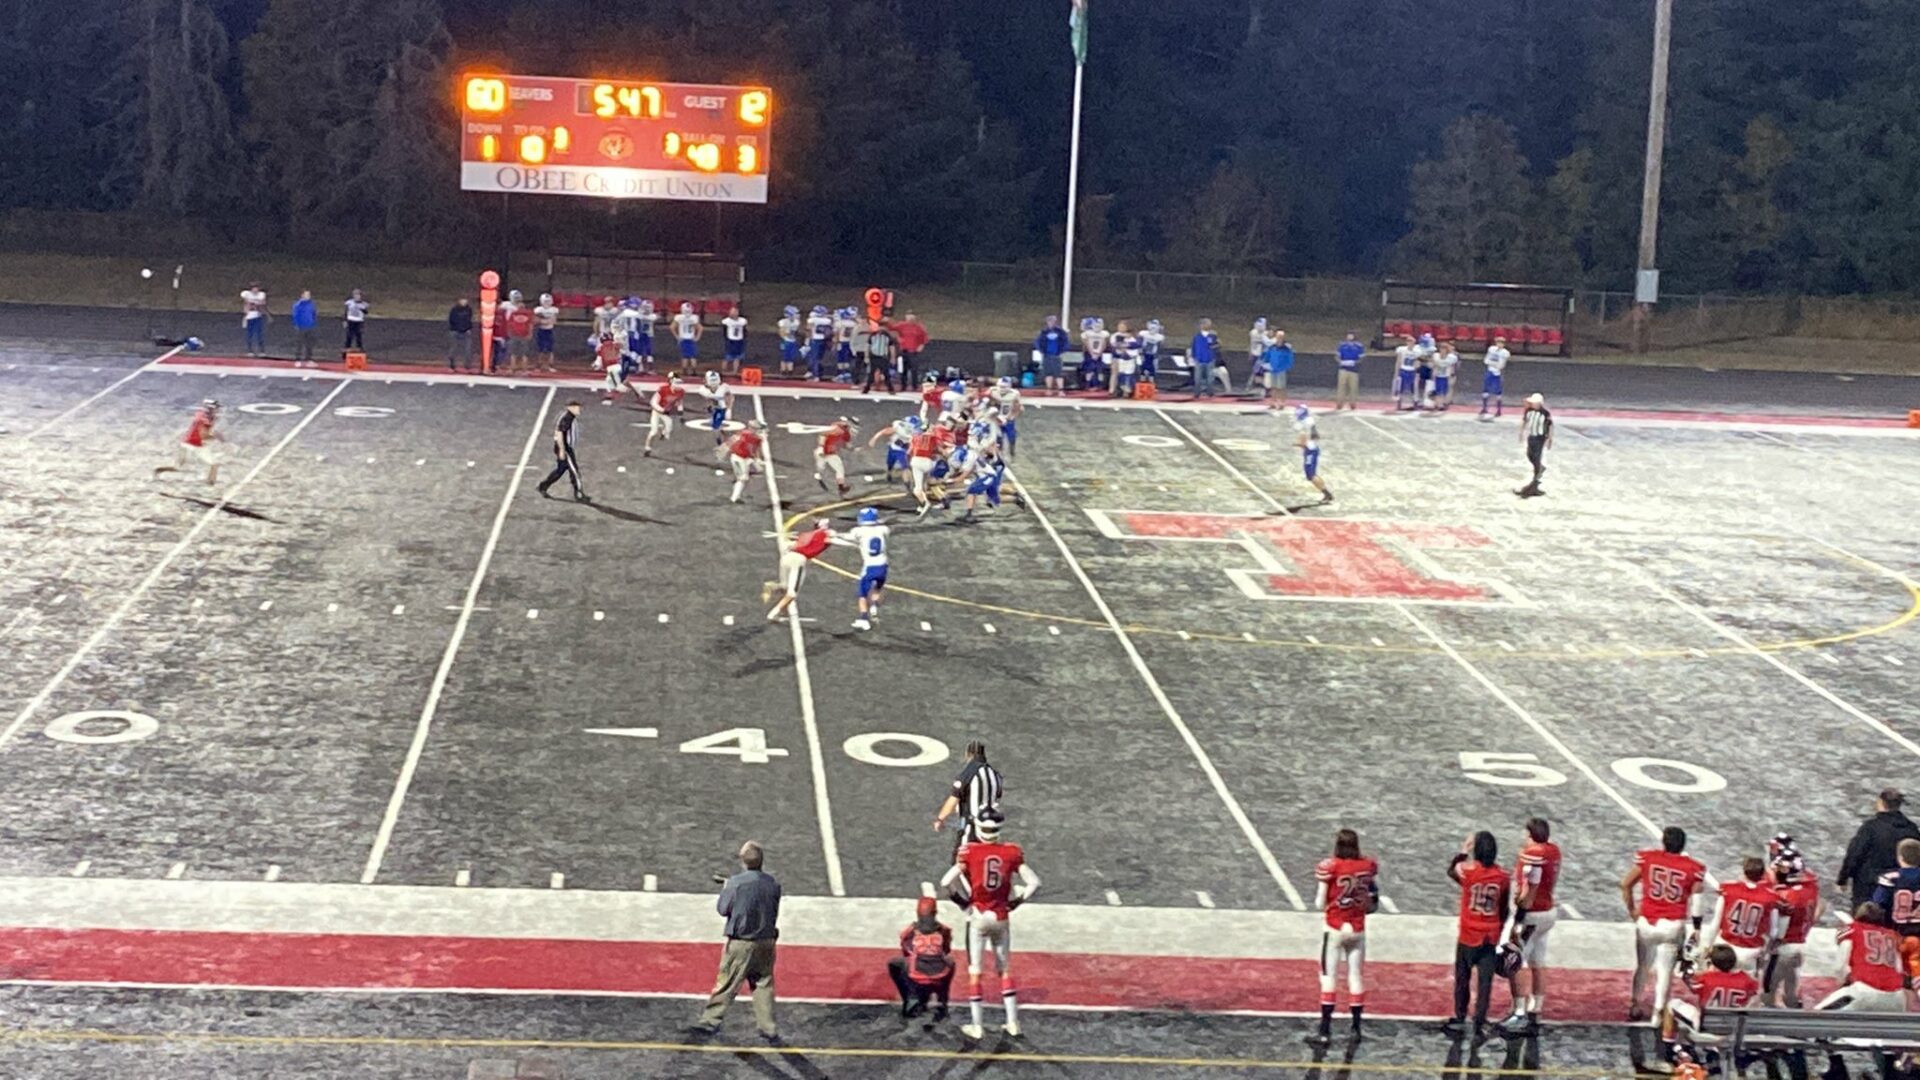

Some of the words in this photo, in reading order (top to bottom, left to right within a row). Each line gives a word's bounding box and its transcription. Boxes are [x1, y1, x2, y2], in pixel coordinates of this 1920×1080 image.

[684, 95, 727, 109] GUEST
[467, 123, 502, 134] DOWN
[496, 166, 577, 190] OBEE
[584, 172, 657, 195] CRDIT
[665, 177, 733, 199] UNION
[869, 536, 883, 556] 9
[983, 854, 1003, 892] 6
[1650, 864, 1686, 902] 55
[1728, 899, 1764, 938] 40
